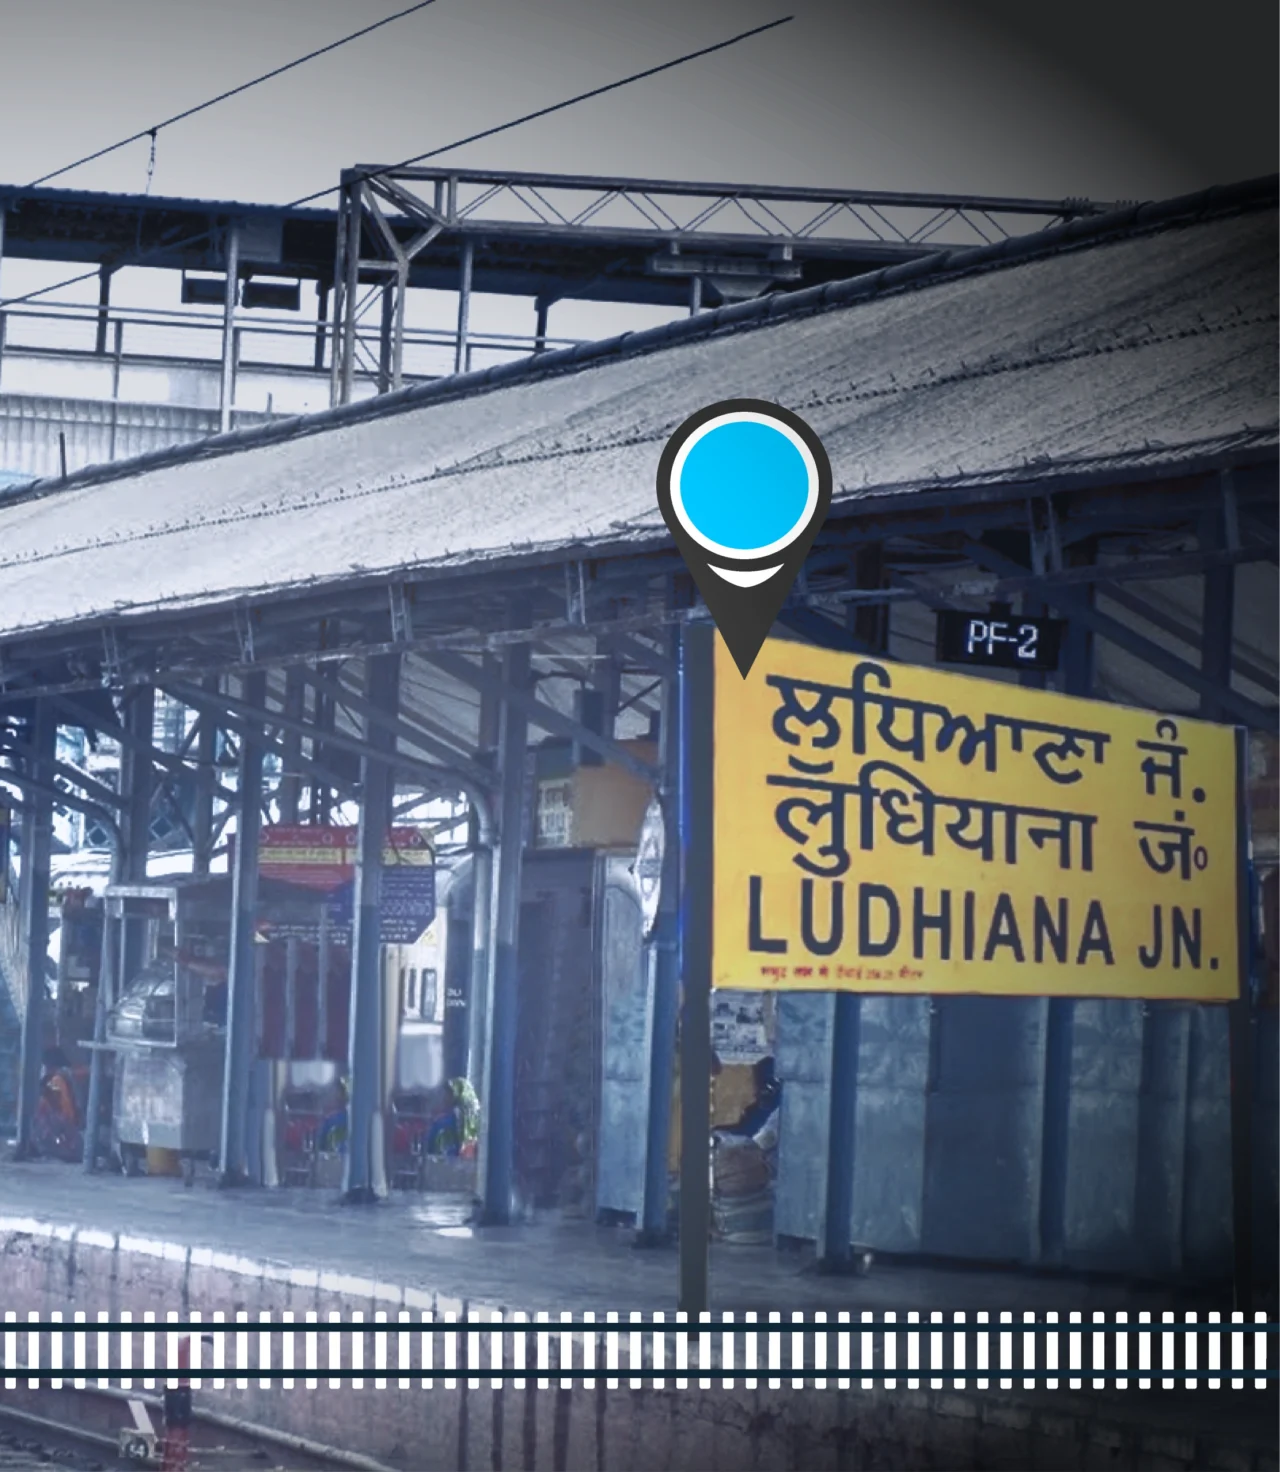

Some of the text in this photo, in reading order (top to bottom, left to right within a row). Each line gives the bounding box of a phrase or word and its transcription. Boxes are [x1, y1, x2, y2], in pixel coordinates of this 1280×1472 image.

[968, 621, 1037, 658] PF-2
[766, 662, 1111, 784] ਲੁਧਿਆਣਾ
[766, 760, 1098, 878] लुधियाना
[748, 875, 1219, 970] LUDHIANA JN.
